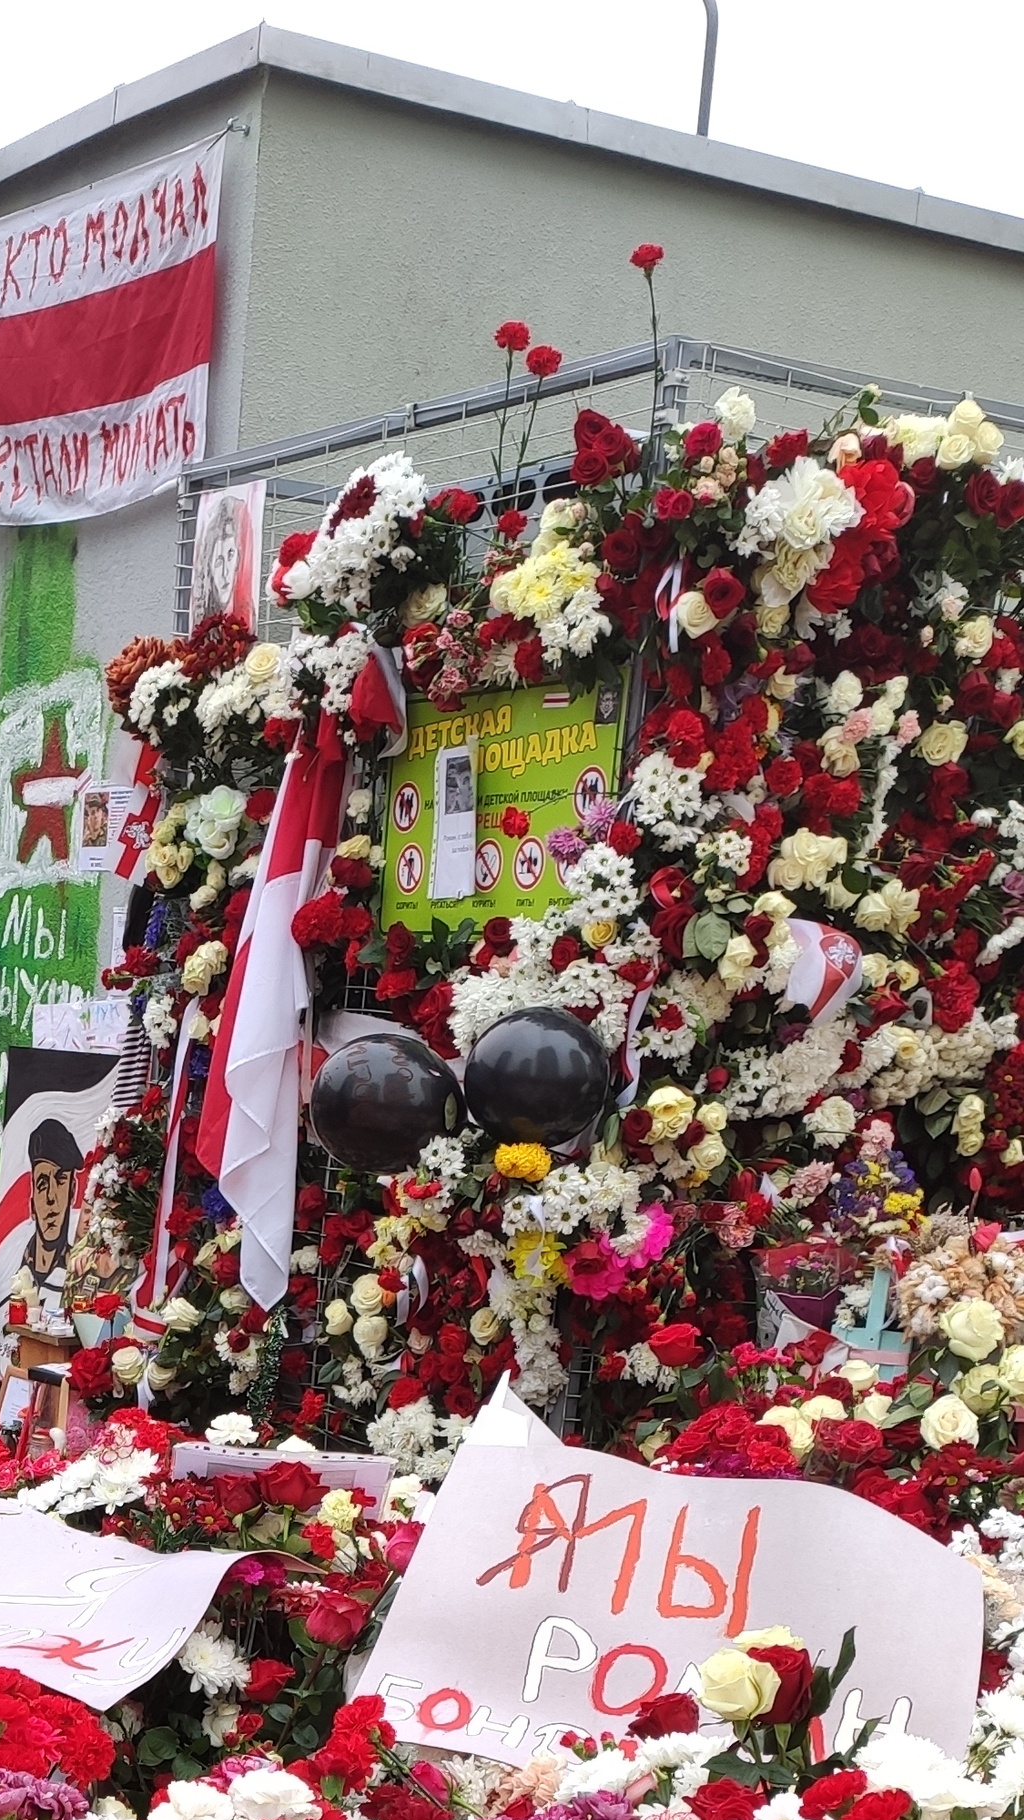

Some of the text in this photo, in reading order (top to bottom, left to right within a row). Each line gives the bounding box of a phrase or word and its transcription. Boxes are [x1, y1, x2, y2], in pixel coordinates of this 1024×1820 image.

[0, 217, 69, 309] КТО
[82, 162, 208, 275] МОЛЧАЛ
[408, 704, 512, 761] ДЕТСКАЯ
[484, 790, 520, 807] ДЕТСКОЙ
[1, 894, 67, 960] МЫ
